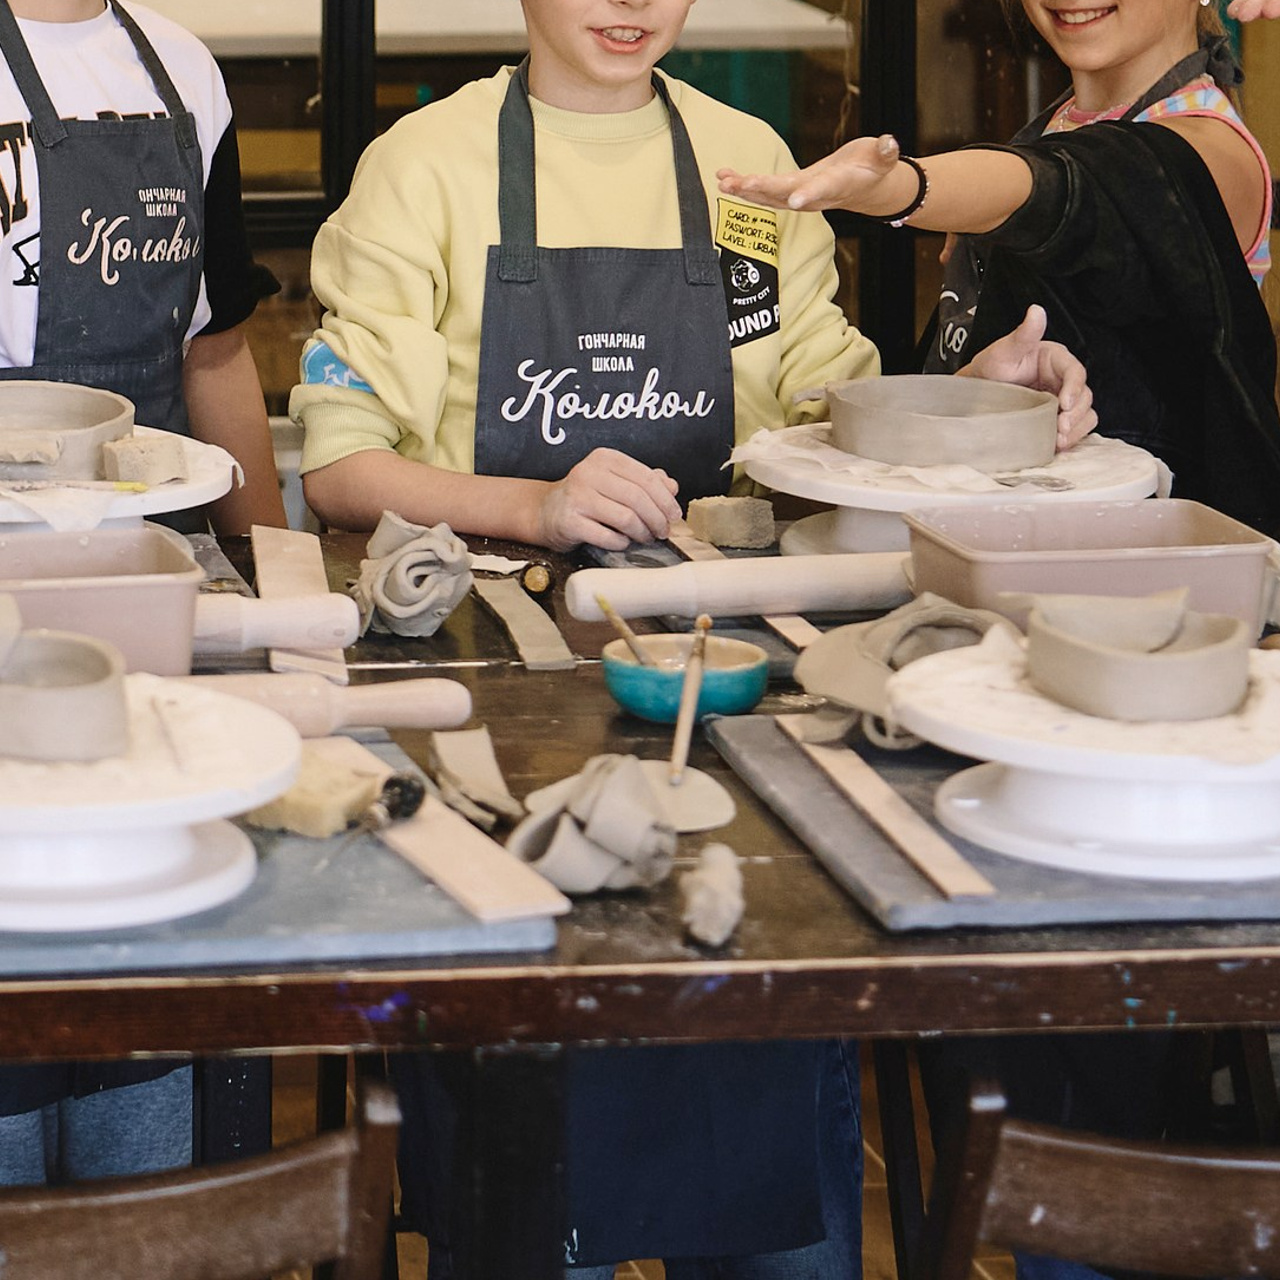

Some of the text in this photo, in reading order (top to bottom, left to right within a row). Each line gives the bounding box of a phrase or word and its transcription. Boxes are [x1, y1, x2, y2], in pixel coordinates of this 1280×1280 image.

[145, 203, 178, 217] ШКОЛА
[732, 285, 771, 305] PRETTY CITY
[578, 332, 646, 350] ГОНЧАРНАЯ
[591, 356, 635, 372] ШКОЛА
[500, 358, 716, 446] Колокол
